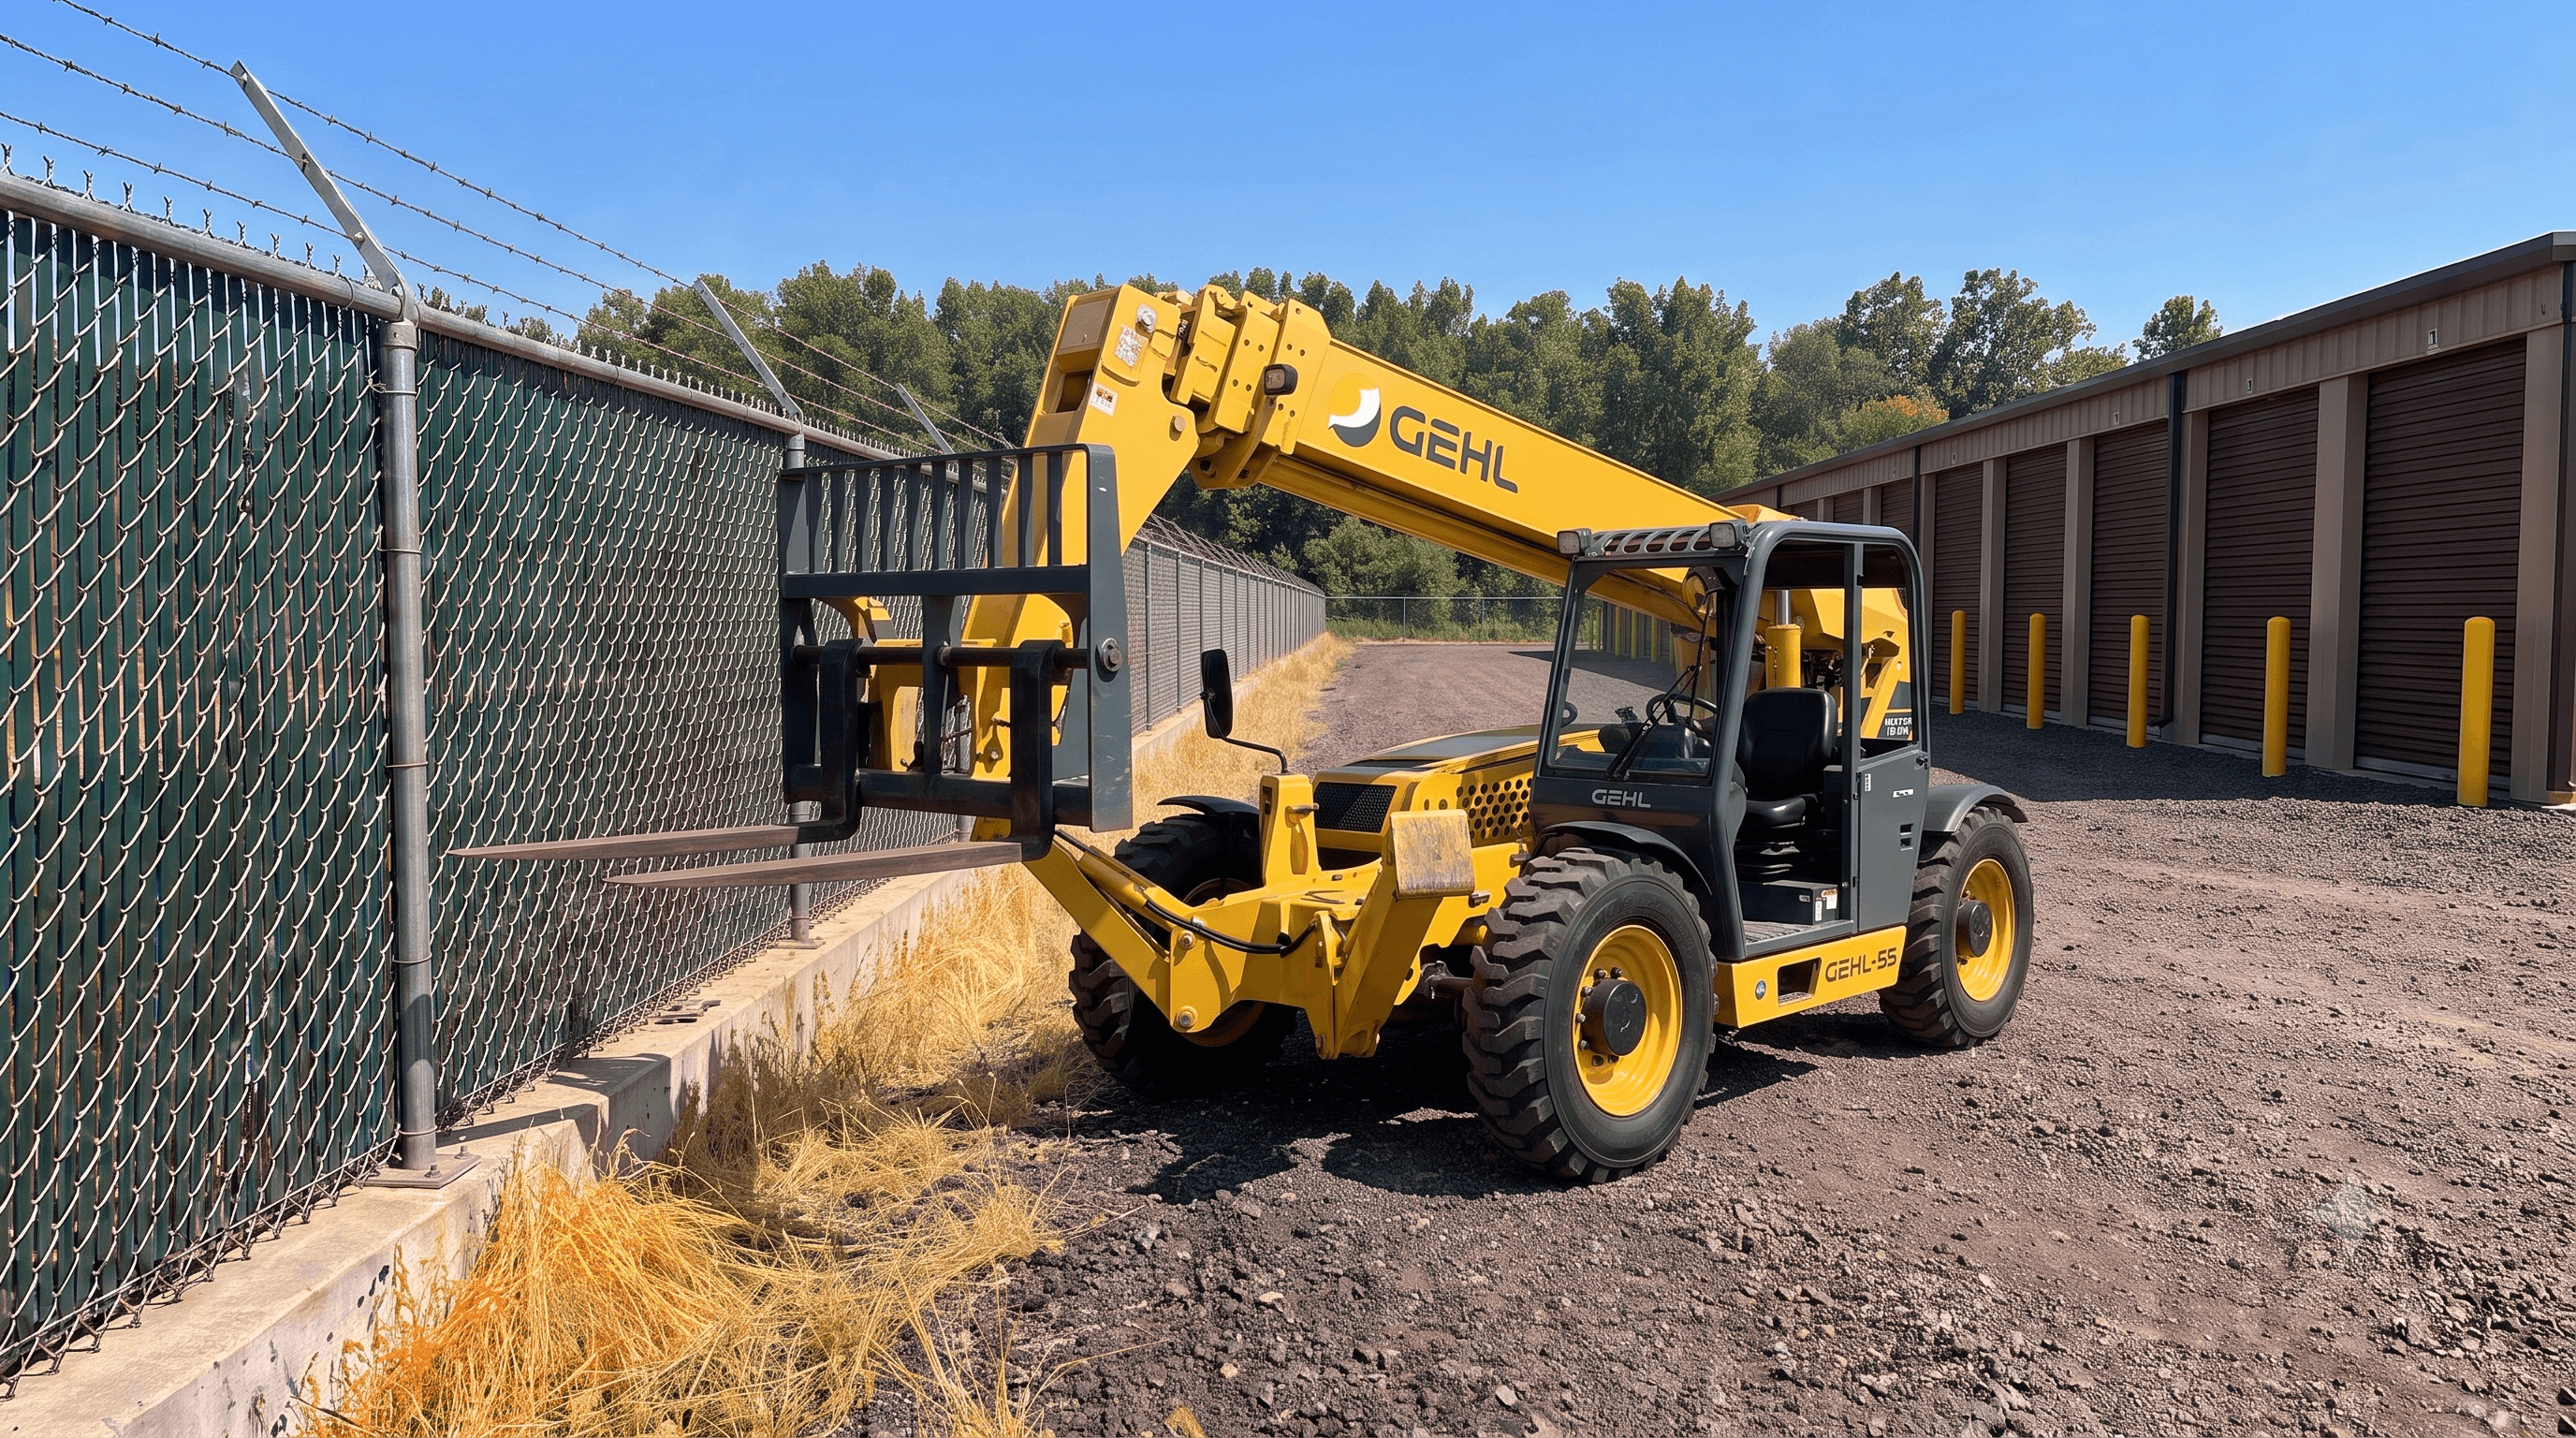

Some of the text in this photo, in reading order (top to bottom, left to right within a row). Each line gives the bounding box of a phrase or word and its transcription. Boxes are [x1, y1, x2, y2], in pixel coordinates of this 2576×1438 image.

[1389, 405, 1518, 494] GEHL
[1591, 788, 1652, 809] GEHL
[1824, 946, 1897, 983] GEHL-55
